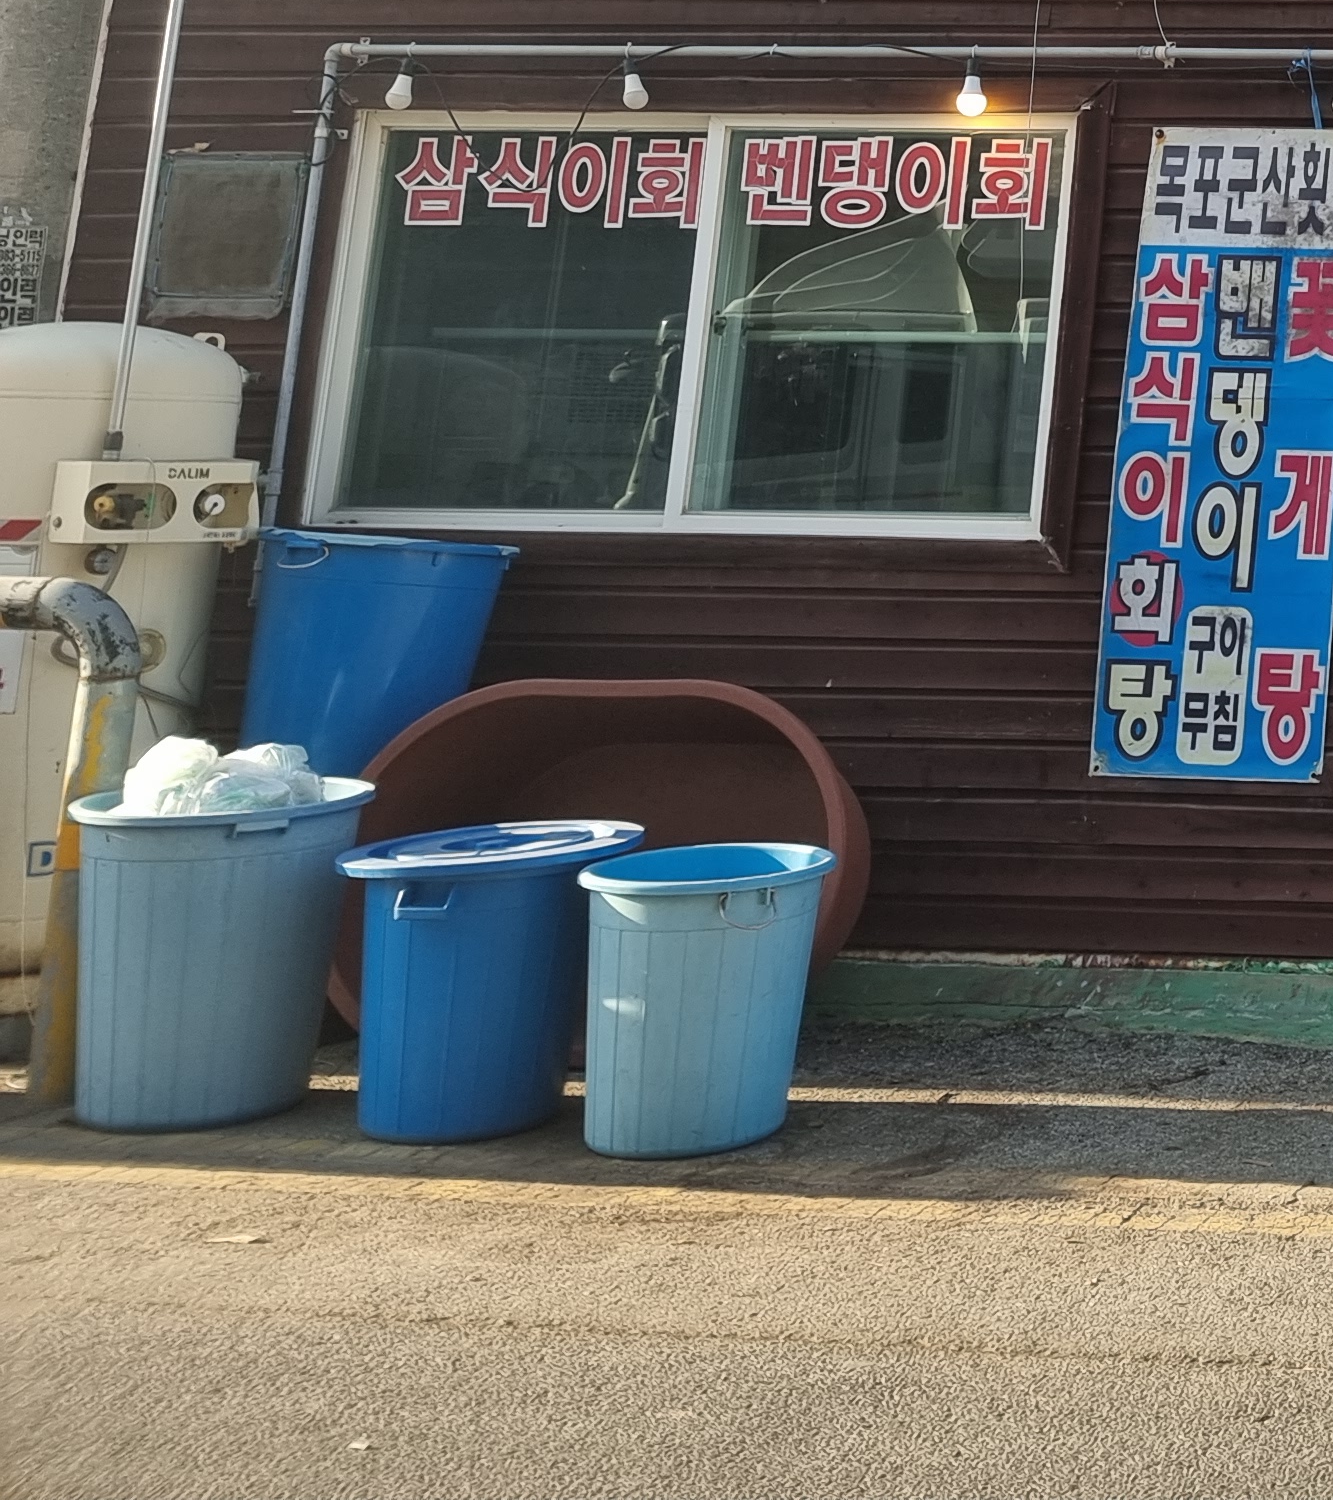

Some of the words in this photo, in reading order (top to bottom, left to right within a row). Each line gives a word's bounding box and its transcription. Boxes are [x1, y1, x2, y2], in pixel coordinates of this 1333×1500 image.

[395, 134, 702, 229] 삼식이회
[741, 134, 1052, 231] 벤댕이회
[168, 468, 210, 480] DALIM
[1188, 615, 1248, 676] 구이
[1181, 690, 1240, 752] 무침
